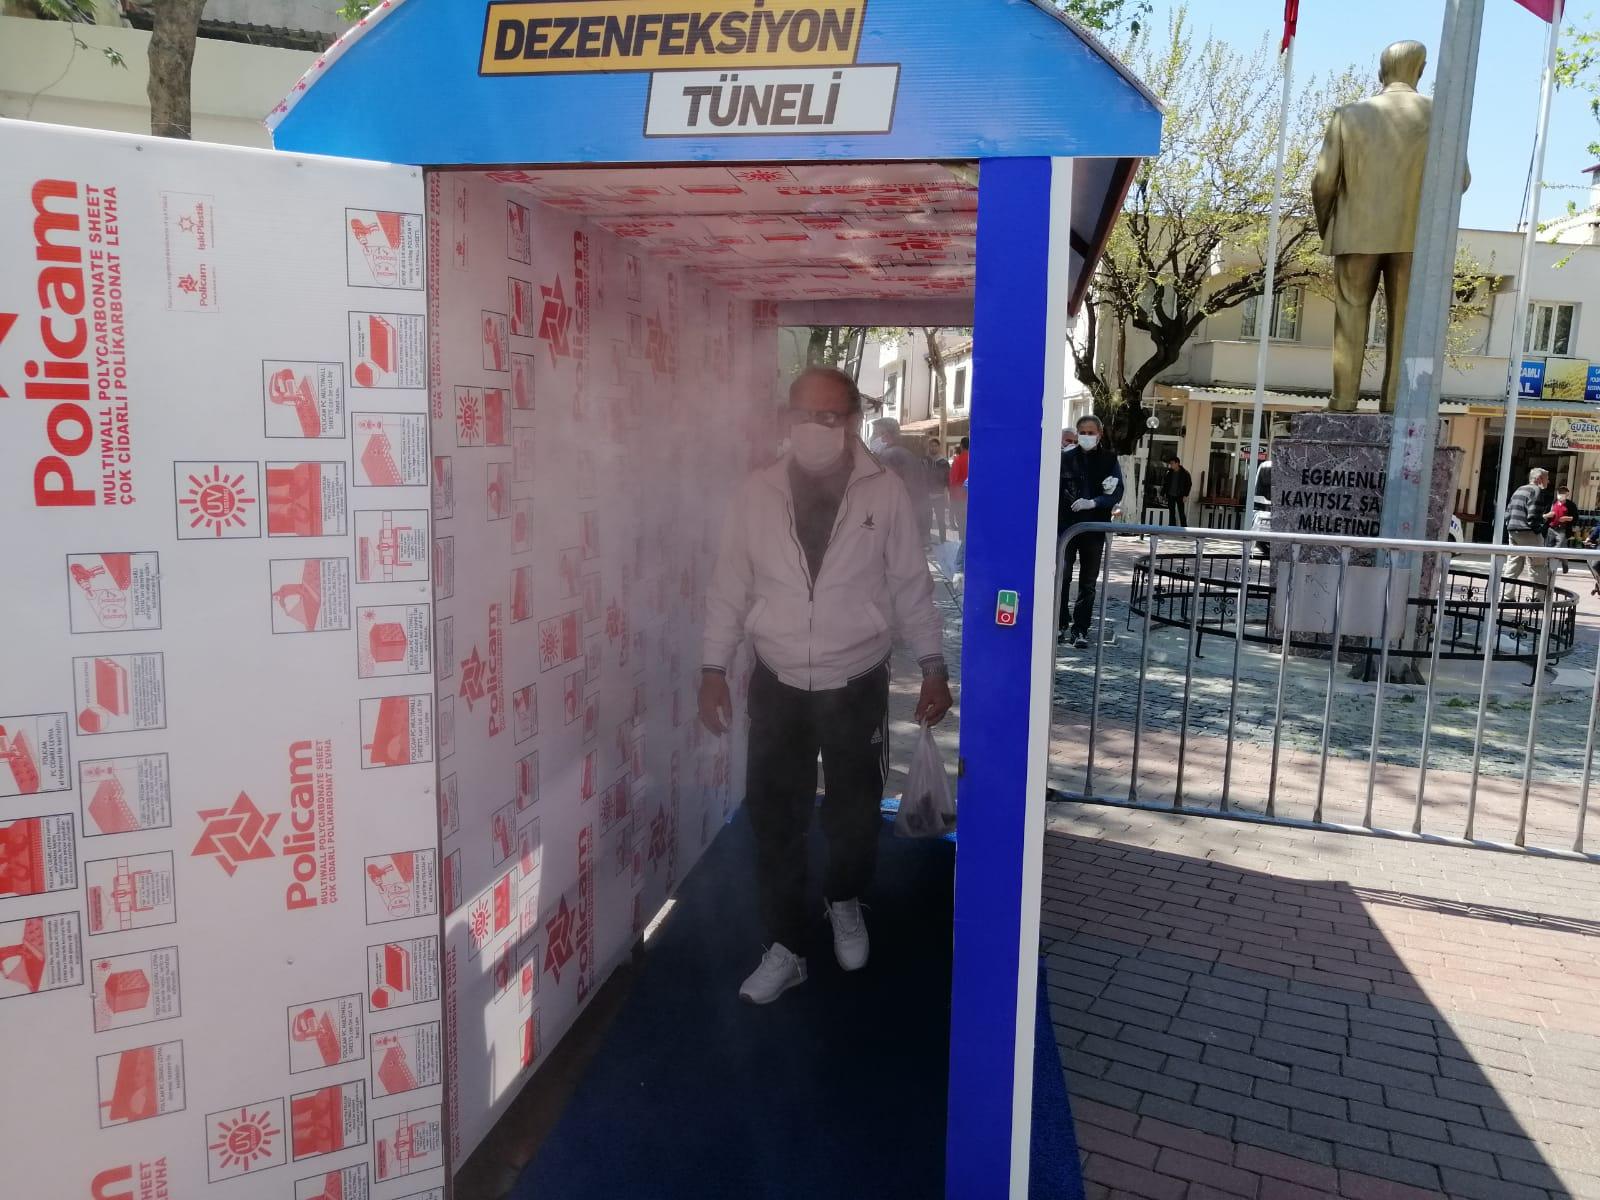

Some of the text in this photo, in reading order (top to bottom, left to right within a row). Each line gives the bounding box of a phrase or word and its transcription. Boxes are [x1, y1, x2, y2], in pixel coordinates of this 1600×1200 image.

[494, 0, 855, 61] DEZENFEKSİYON
[683, 71, 842, 127] TÜNELİ
[103, 186, 119, 246] LEVHA
[199, 263, 208, 307] Policam
[24, 179, 95, 506] Policam
[86, 184, 117, 505] MULTIWALL POLYCARBONATE SHEET
[119, 469, 136, 505] ÇOK
[206, 488, 224, 513] UV
[1301, 468, 1386, 491] EGEMENLİ
[1281, 490, 1382, 514] KAYITSIZ ŞA
[1298, 511, 1380, 537] MİLLETİND
[486, 604, 499, 737] Policam
[324, 739, 333, 770] LEVHA
[283, 740, 317, 910] Policam
[315, 740, 328, 905] MULTIWALL POLYCARBONATE SHEET
[575, 827, 588, 1004] Policam
[235, 1131, 250, 1152] UV
[139, 1162, 153, 1200] HEET
[154, 1156, 169, 1200] EVHA
